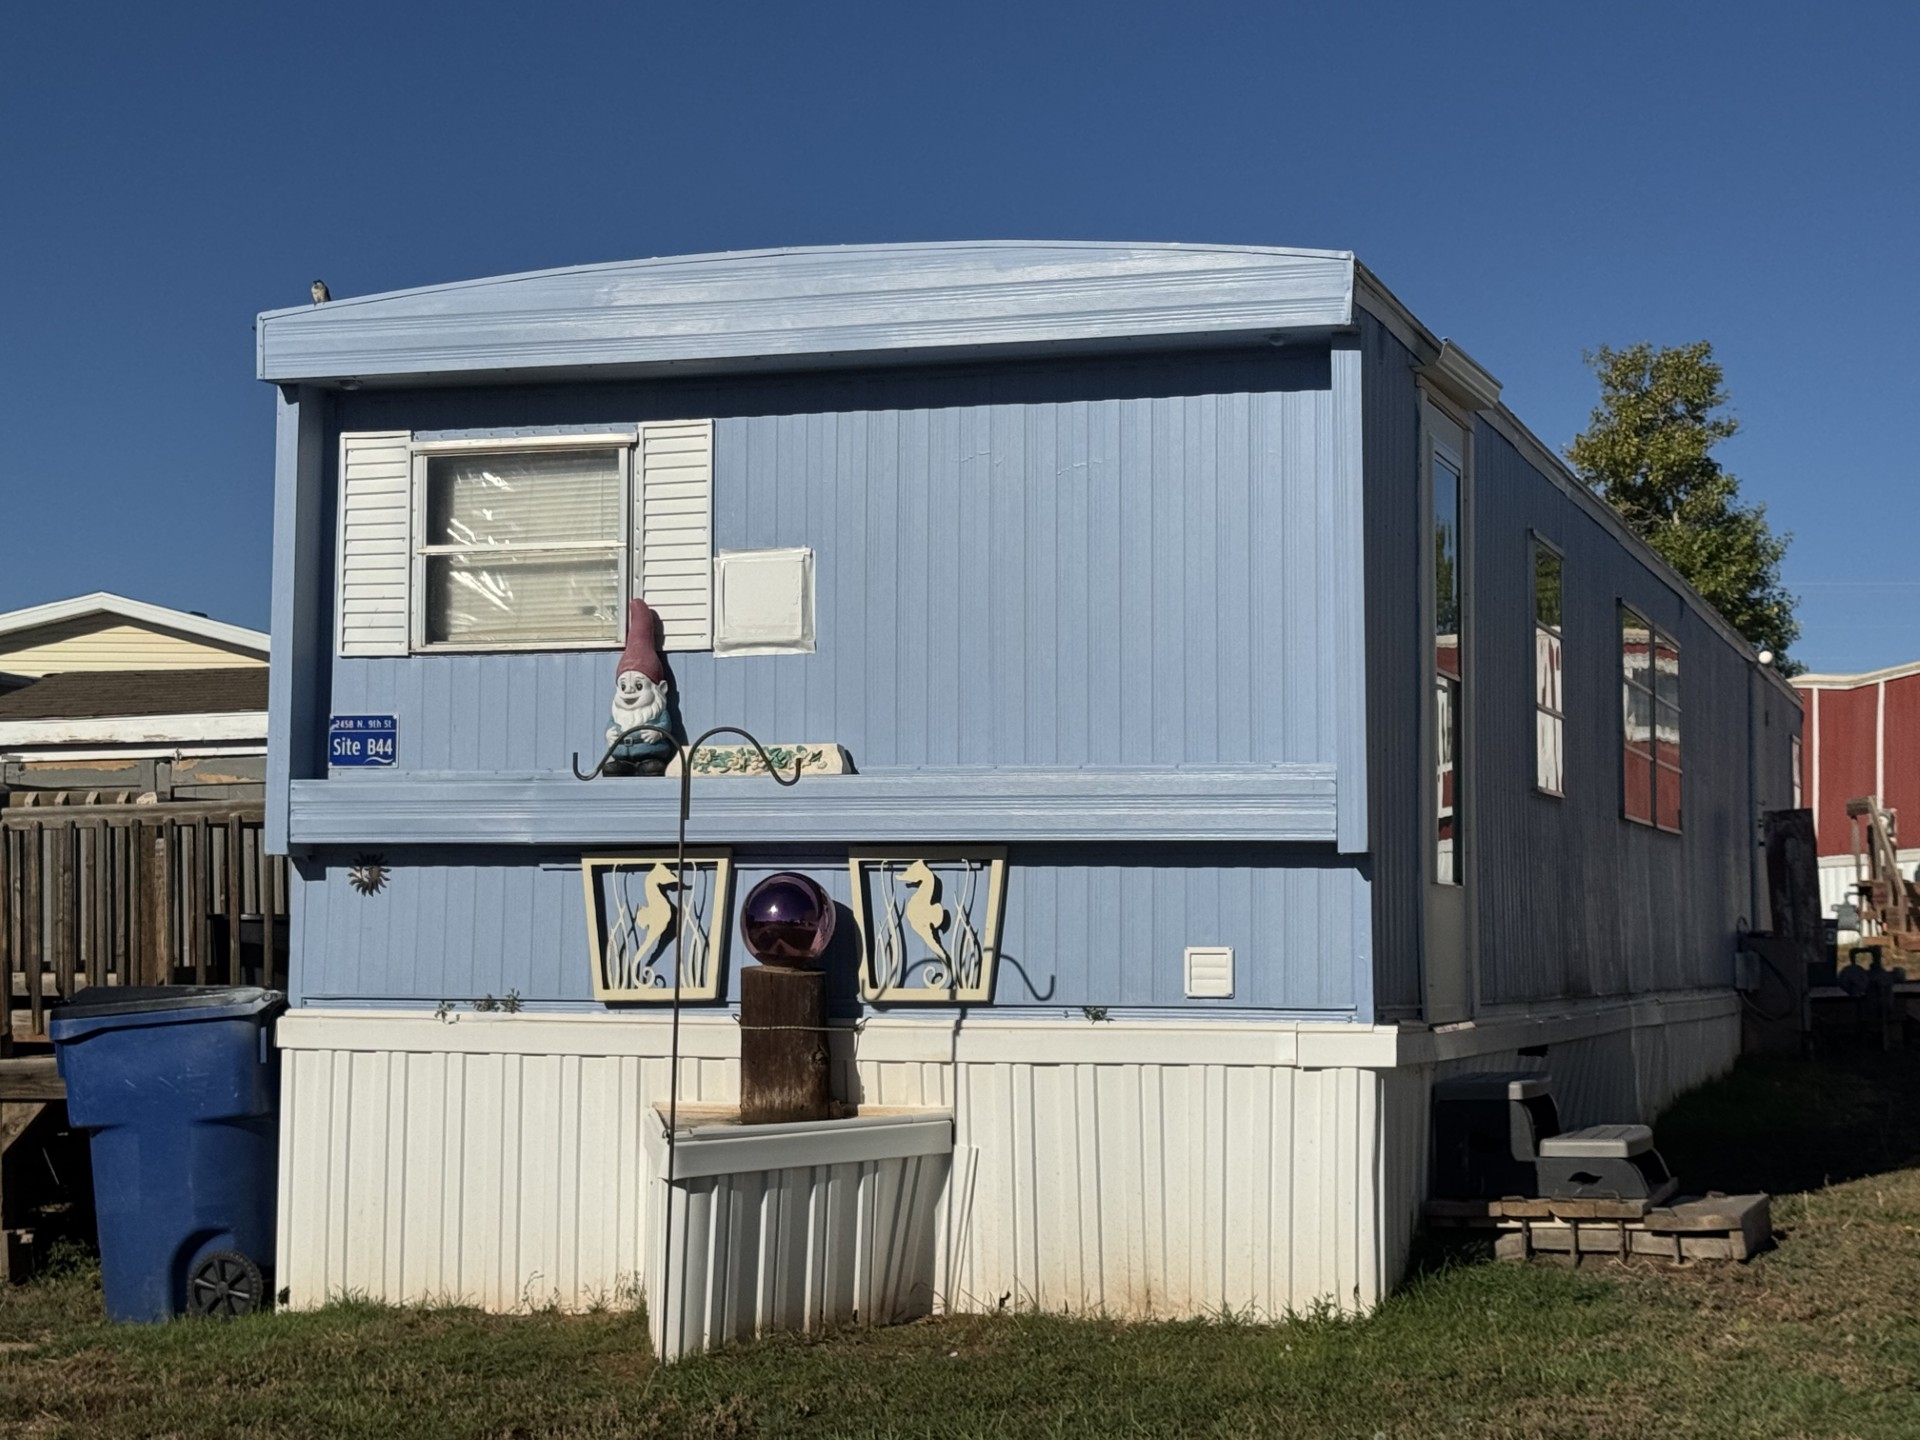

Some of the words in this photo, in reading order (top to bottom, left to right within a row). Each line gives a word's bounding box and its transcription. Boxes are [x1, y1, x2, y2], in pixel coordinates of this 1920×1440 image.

[368, 719, 382, 728] 9th
[384, 719, 392, 728] St
[333, 736, 361, 756] Site
[367, 738, 393, 756] B44
